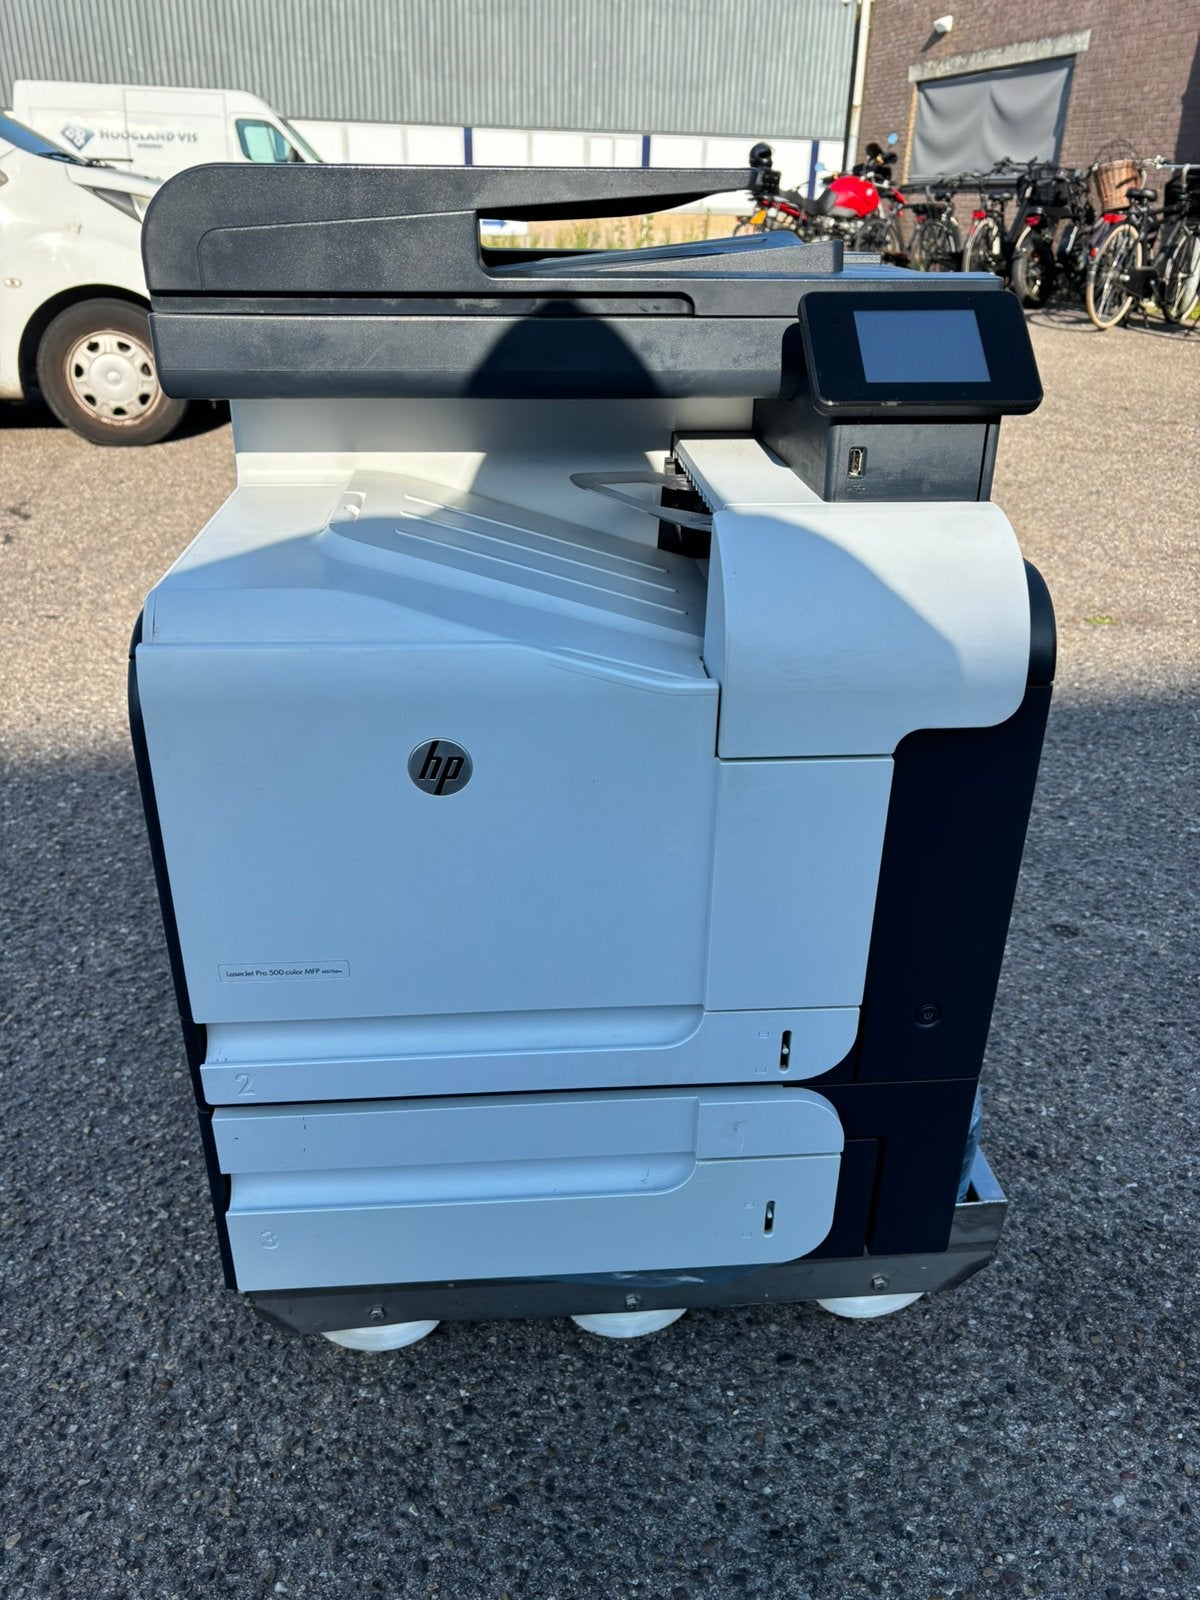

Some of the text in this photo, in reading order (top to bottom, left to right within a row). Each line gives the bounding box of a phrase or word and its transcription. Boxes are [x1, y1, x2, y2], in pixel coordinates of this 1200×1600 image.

[178, 132, 198, 142] VIS
[418, 740, 465, 796] hp
[255, 969, 268, 977] Pro
[285, 968, 303, 976] color
[304, 967, 321, 975] MFP
[235, 1072, 256, 1096] 2
[260, 1230, 280, 1250] 3
